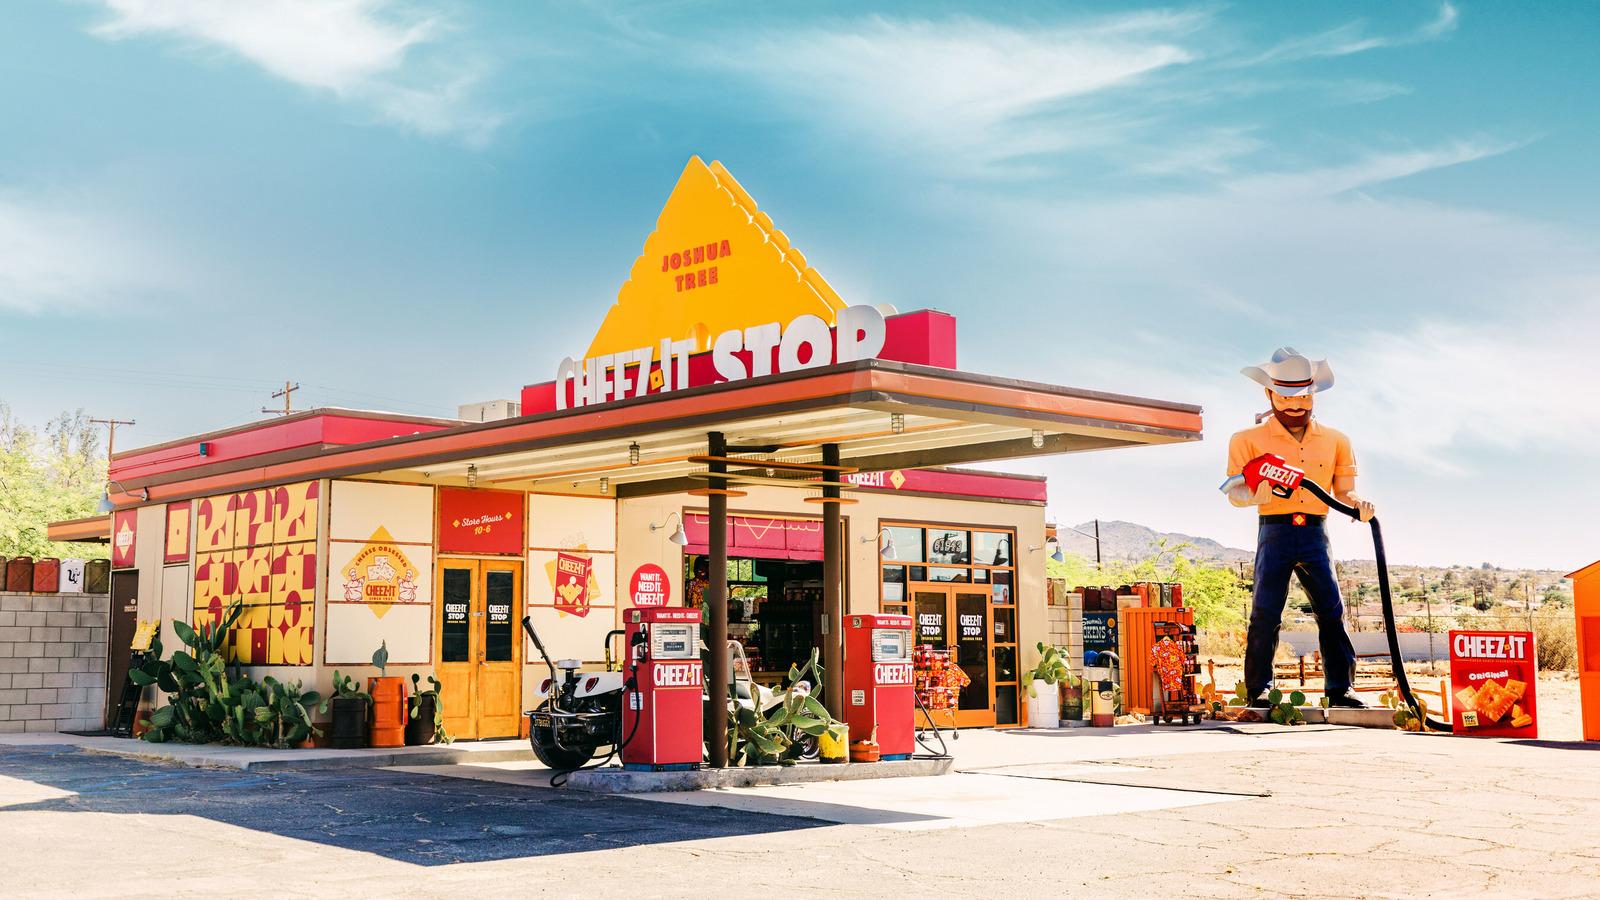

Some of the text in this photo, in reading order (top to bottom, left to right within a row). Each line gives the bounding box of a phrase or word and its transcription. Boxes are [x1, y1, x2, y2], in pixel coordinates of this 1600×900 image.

[662, 239, 731, 273] JOSHUA
[675, 266, 718, 293] TREE
[712, 304, 887, 385] STOP
[461, 514, 503, 527] Store Hours
[474, 524, 492, 535] 10-6
[355, 545, 408, 568] CHEESE OBSESSED
[640, 572, 655, 582] WANT
[638, 581, 654, 592] NEED
[491, 613, 508, 621] STOP
[922, 626, 940, 635] STOP
[963, 627, 981, 636] STOP
[1083, 625, 1106, 640] OKENS
